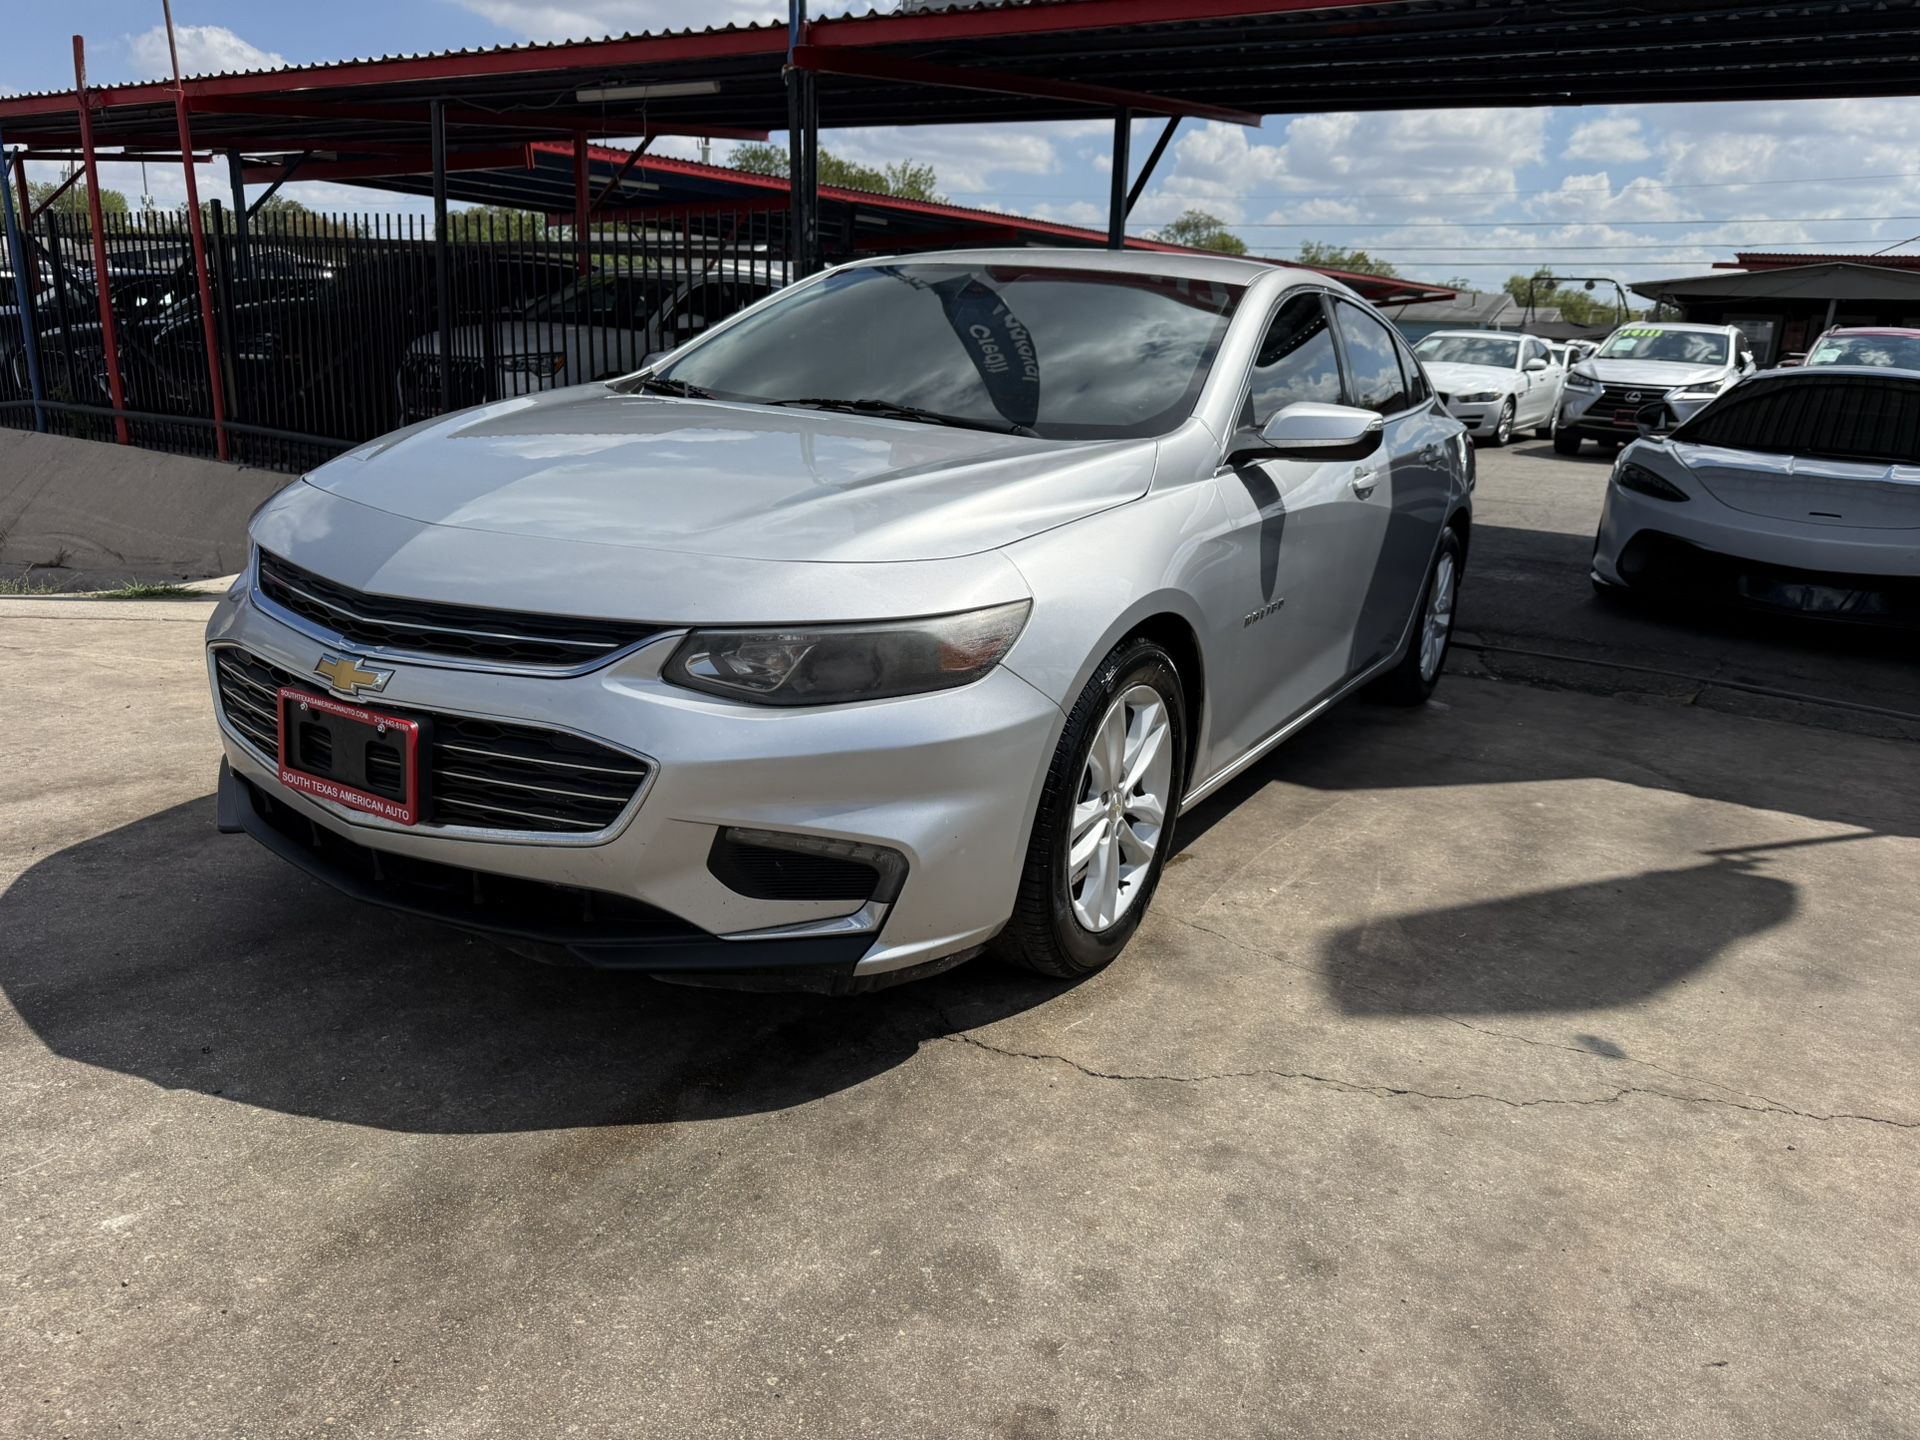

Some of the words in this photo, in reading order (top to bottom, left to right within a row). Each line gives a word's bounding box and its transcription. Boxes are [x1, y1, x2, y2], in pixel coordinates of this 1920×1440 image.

[282, 771, 310, 789] SOUTH
[311, 781, 338, 798] TEXAS
[338, 790, 384, 813] AMERICAN
[384, 805, 410, 821] AUTO
